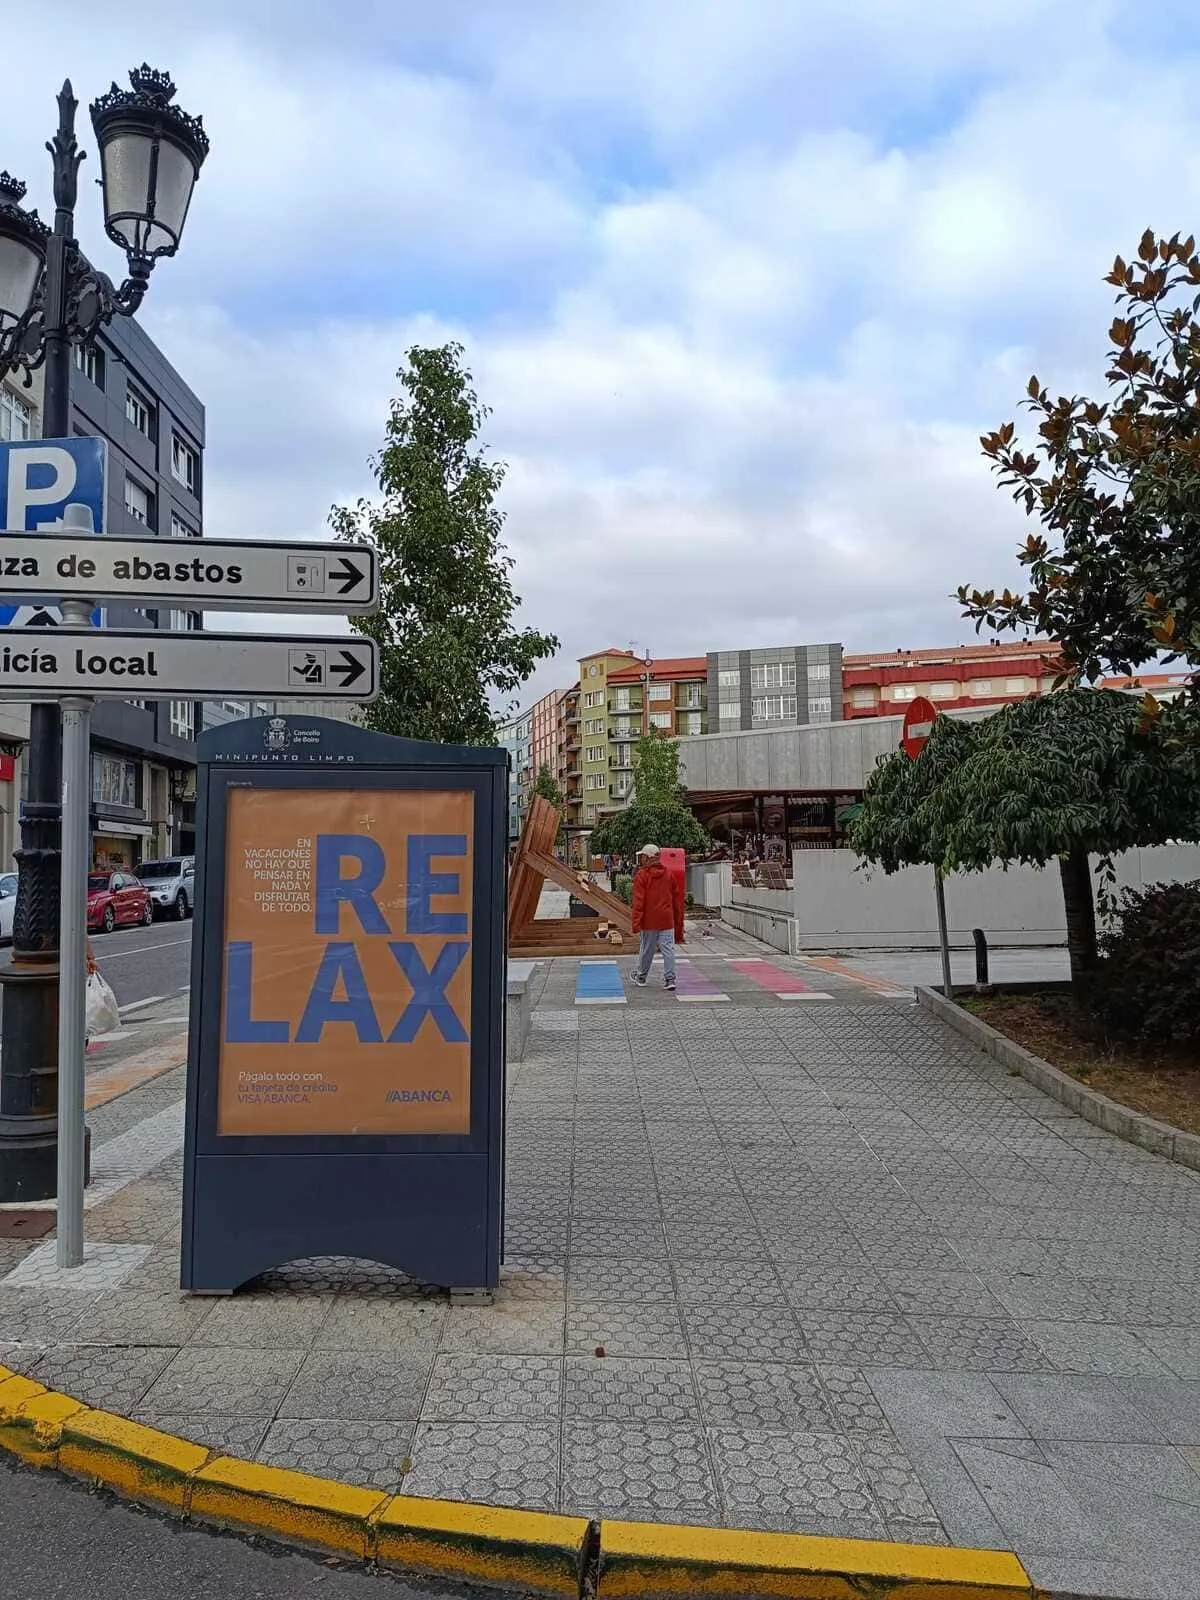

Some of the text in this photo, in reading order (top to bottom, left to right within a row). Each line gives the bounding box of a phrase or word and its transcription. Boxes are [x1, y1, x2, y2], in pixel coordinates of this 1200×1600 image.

[7, 447, 77, 531] P
[0, 554, 243, 584] za de abastos
[0, 647, 157, 676] icía local
[297, 838, 311, 848] EN
[244, 848, 311, 858] VACACIONES
[245, 860, 311, 869] NO HAY QUE
[254, 870, 310, 880] PENSAR EN
[272, 880, 310, 890] NADA Y
[315, 834, 468, 934] RE
[254, 892, 310, 900] DISFRUTAR
[262, 902, 312, 912] DE TODO.
[225, 942, 471, 1043] LAX
[240, 1072, 274, 1083] Págalo
[276, 1072, 300, 1081] todo
[238, 1084, 248, 1092] tu
[286, 1084, 300, 1092] de
[238, 1094, 261, 1104] VISA
